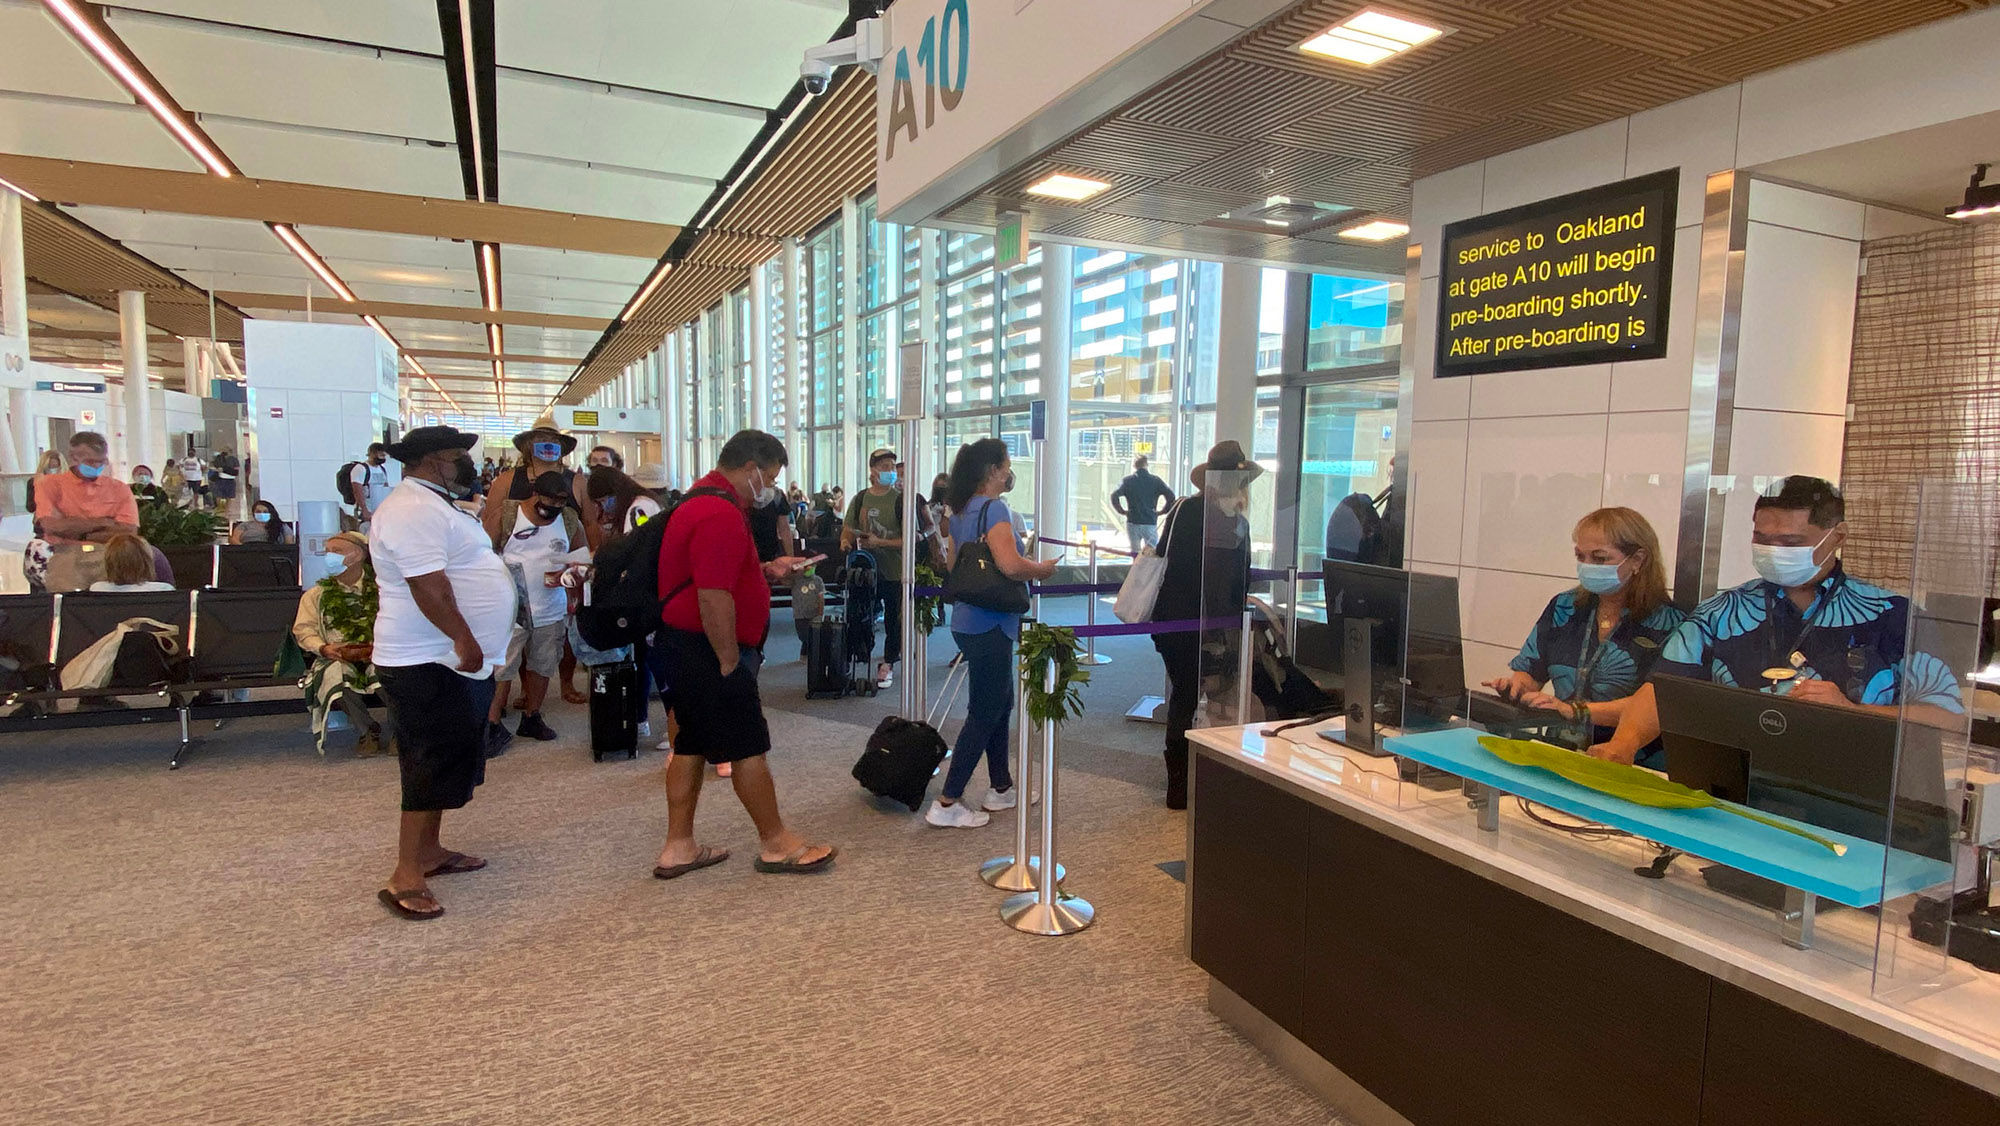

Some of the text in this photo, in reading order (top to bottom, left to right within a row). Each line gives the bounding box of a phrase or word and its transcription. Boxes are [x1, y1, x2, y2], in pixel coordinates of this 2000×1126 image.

[886, 0, 969, 161] A10
[1458, 206, 1646, 265] service to Oakland
[1449, 243, 1656, 298] at gate A10 will begin
[1450, 281, 1648, 331] pre-boarding shortly.
[1450, 316, 1646, 357] After pre-boarding is
